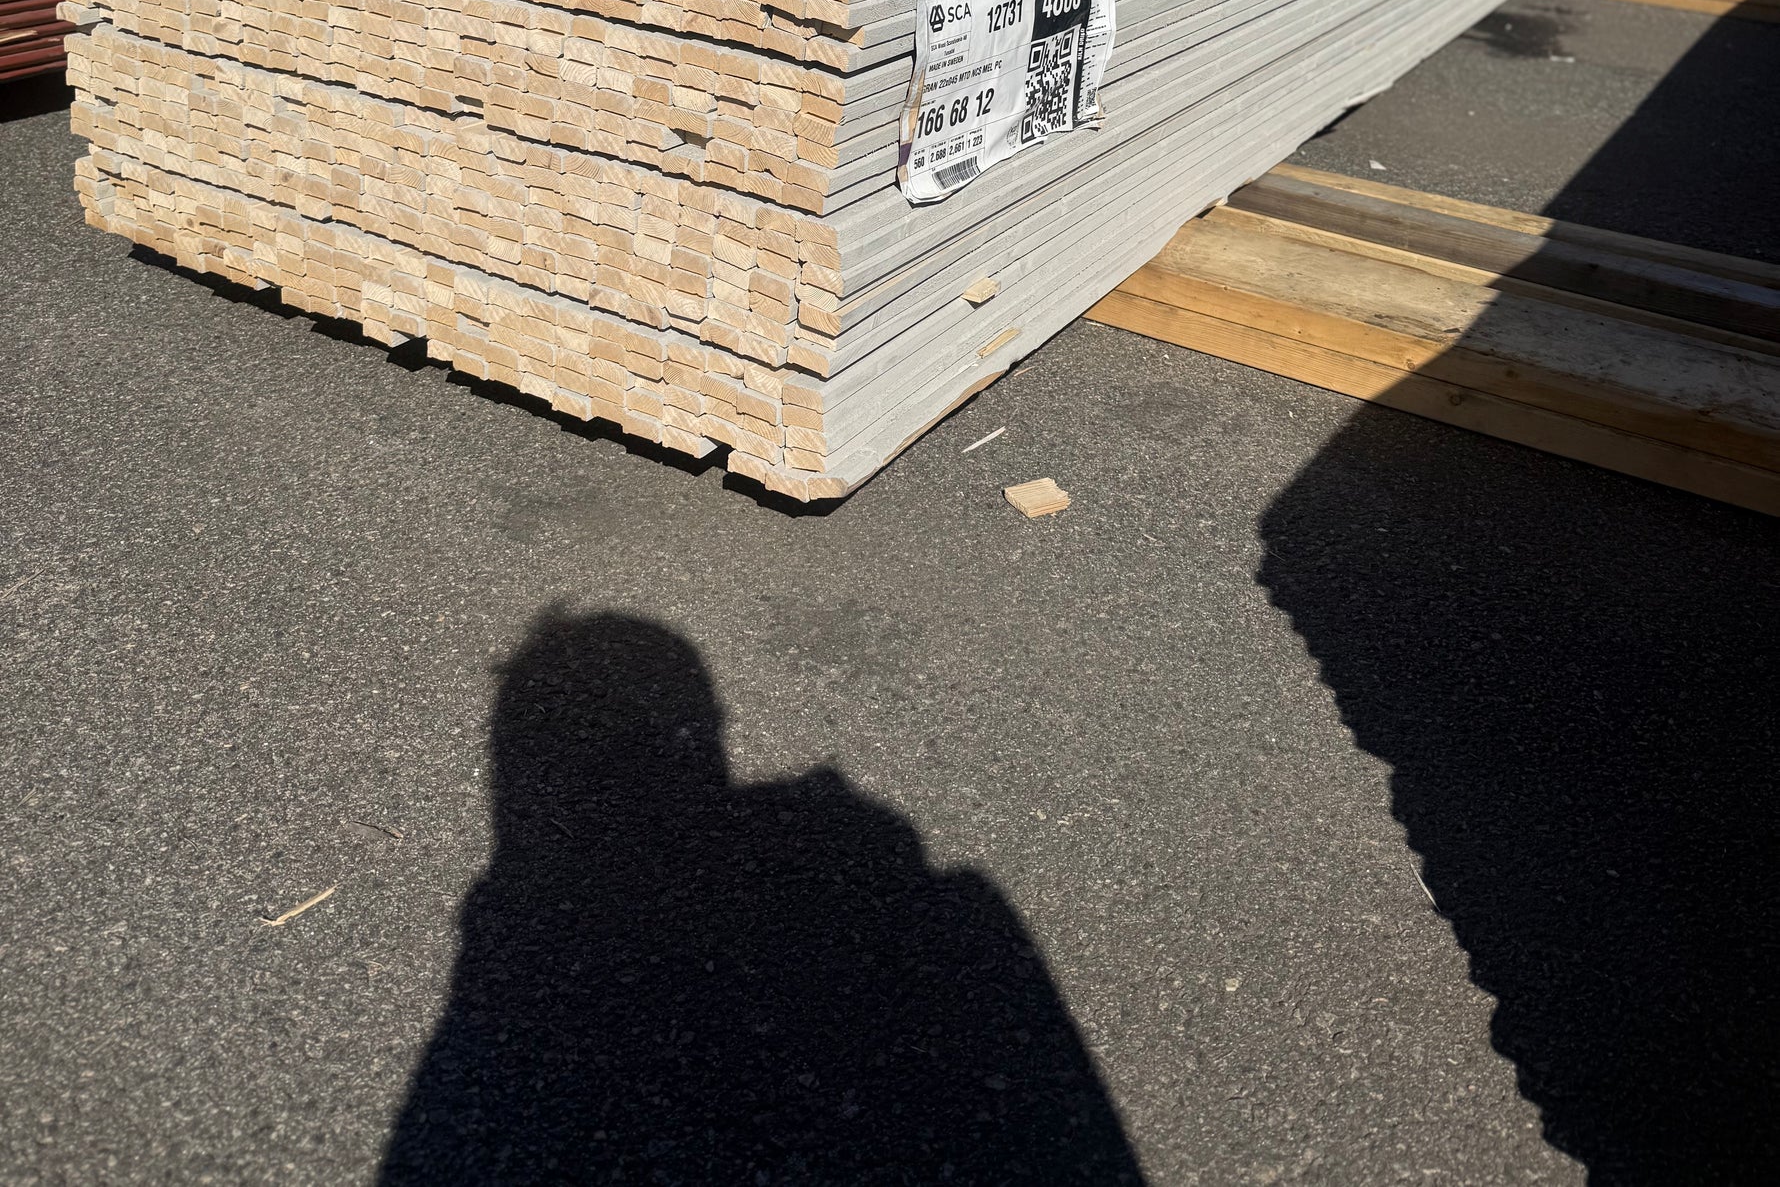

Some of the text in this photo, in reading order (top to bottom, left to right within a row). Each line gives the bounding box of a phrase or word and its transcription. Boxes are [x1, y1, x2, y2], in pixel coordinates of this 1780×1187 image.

[947, 2, 972, 23] SCA
[928, 55, 964, 72] MADE IN SWEDEN
[917, 88, 995, 139] 166 68 12
[972, 135, 983, 147] 223
[914, 156, 925, 169] 560
